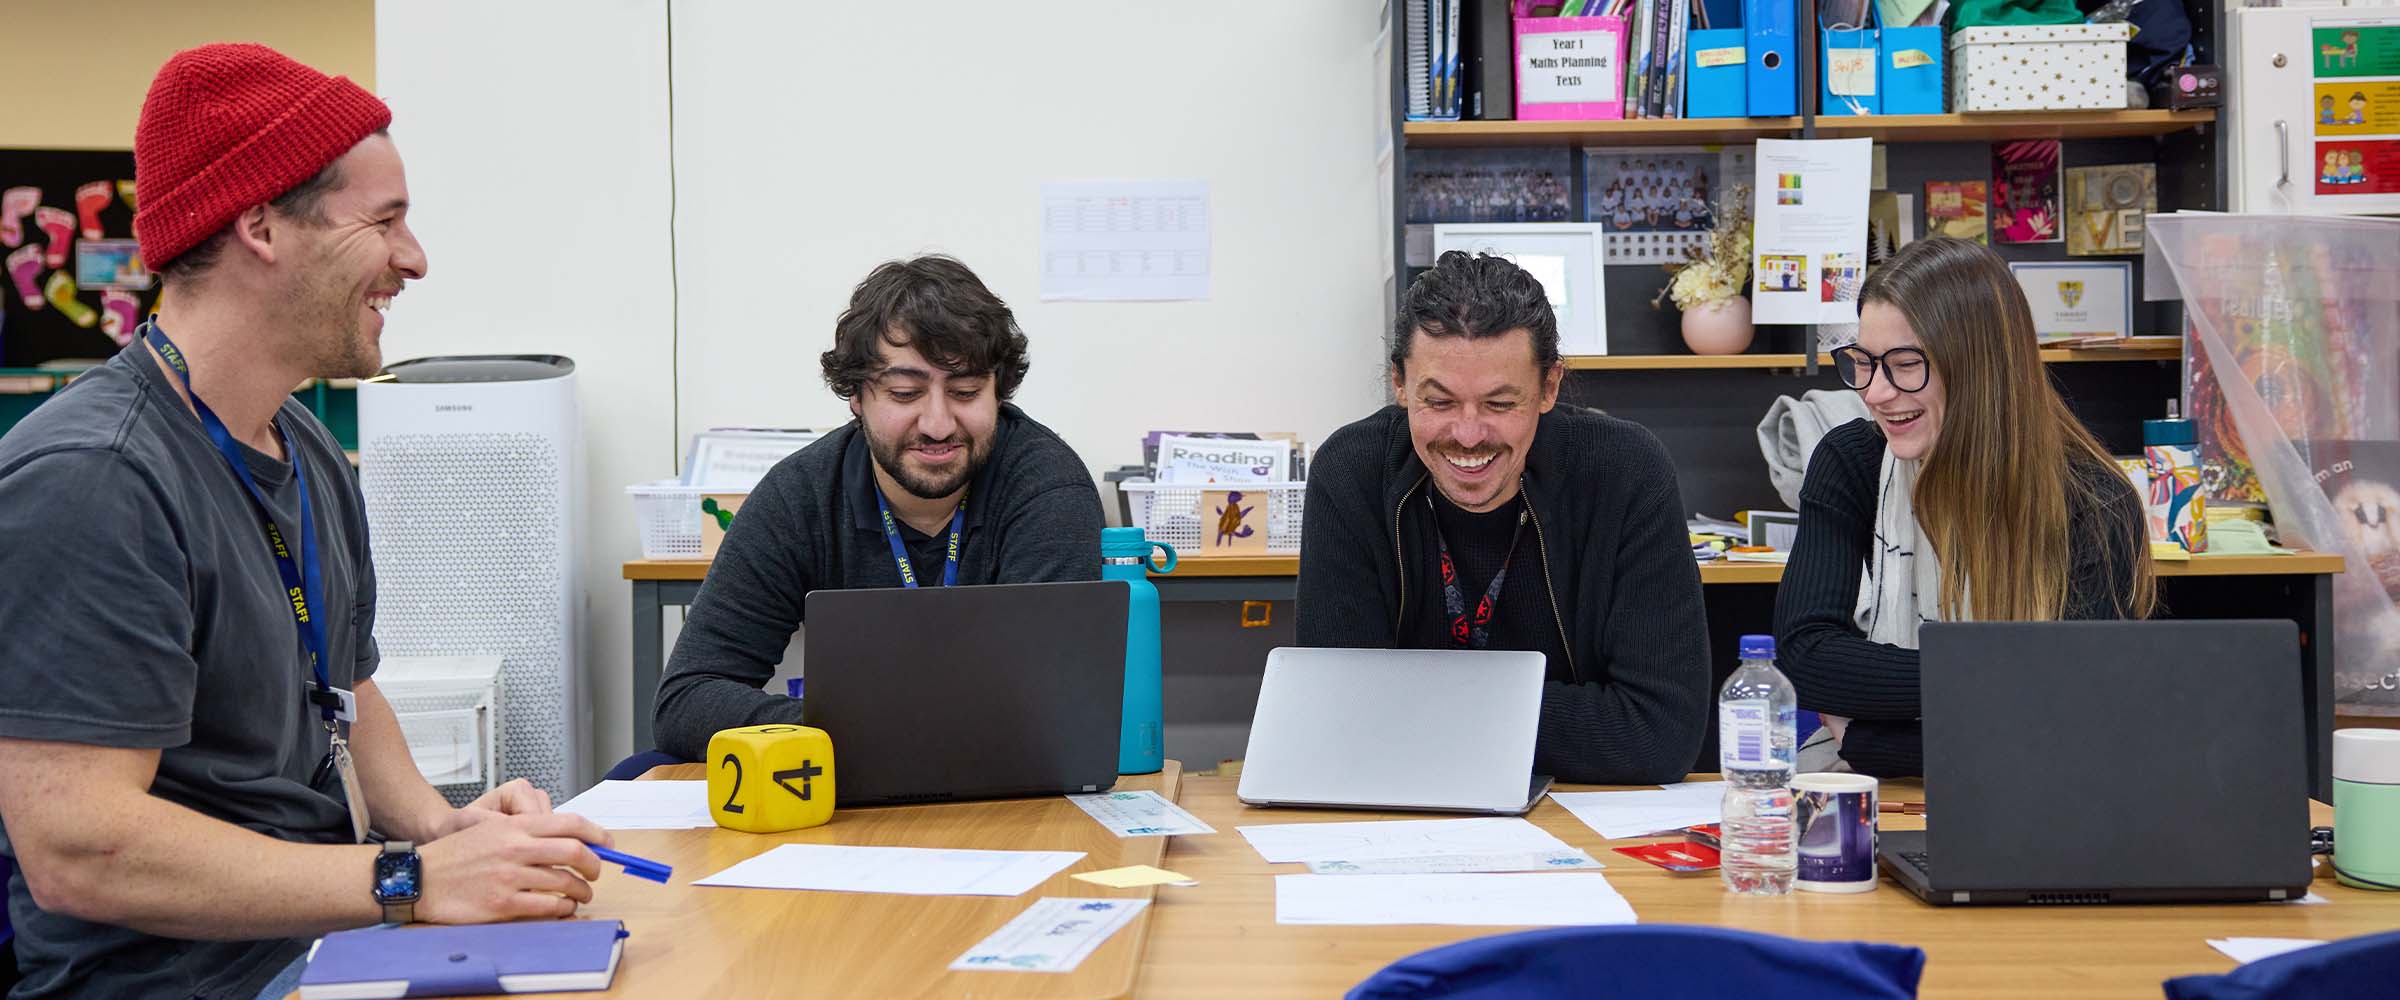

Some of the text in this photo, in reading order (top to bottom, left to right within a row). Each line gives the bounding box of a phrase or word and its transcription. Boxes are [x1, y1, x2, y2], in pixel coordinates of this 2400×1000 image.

[1552, 39, 1584, 50] Year 1
[1530, 56, 1607, 68] Maths Planning
[1555, 75, 1582, 86] Texts
[160, 344, 186, 373] STAFF
[1172, 447, 1274, 468] Reading
[2333, 460, 2353, 473] an
[268, 523, 288, 558] STAFF
[948, 533, 959, 561] STAFF
[898, 557, 914, 584] STAFF
[290, 587, 310, 623] STAFF
[722, 753, 745, 814] 2
[772, 759, 823, 802] 4
